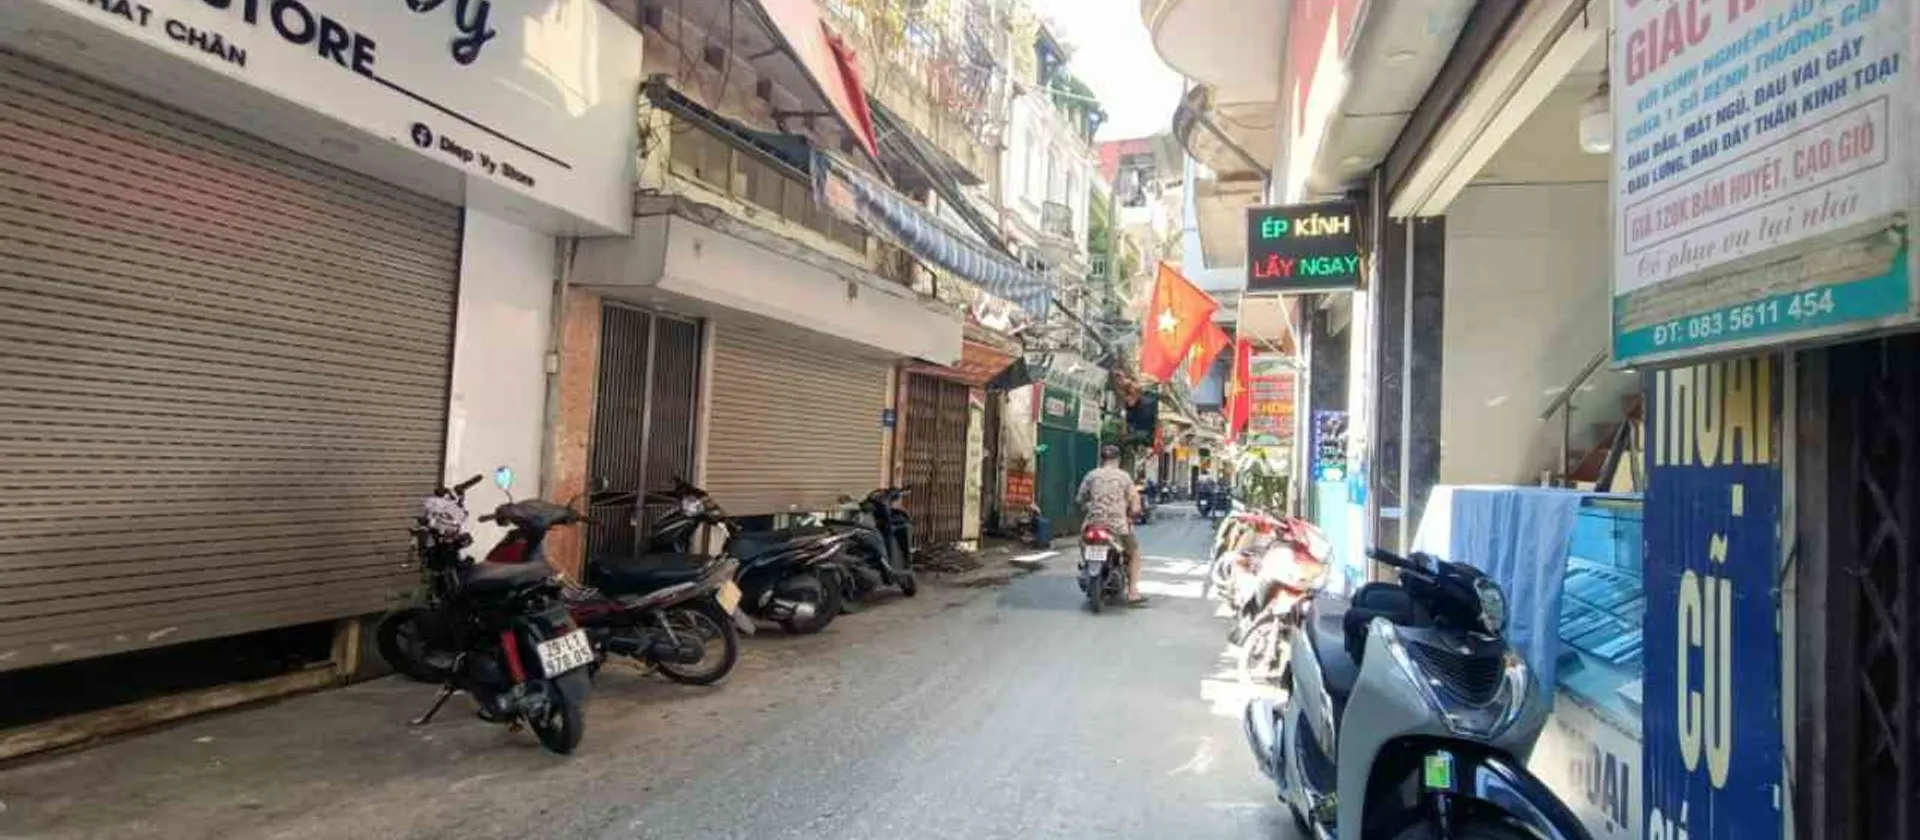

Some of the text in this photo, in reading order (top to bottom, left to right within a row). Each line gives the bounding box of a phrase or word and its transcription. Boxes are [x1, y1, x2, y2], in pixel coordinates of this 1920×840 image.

[1792, 57, 1820, 88] VAI
[1802, 76, 1848, 114] KINH
[1794, 136, 1832, 182] CẠO
[1262, 212, 1350, 239] ÉP KÍNH
[1300, 254, 1359, 276] NGAY
[1689, 311, 1722, 340] 083
[1729, 300, 1778, 332] 5611
[1788, 287, 1835, 321] 454
[1678, 532, 1733, 790] CŨ
